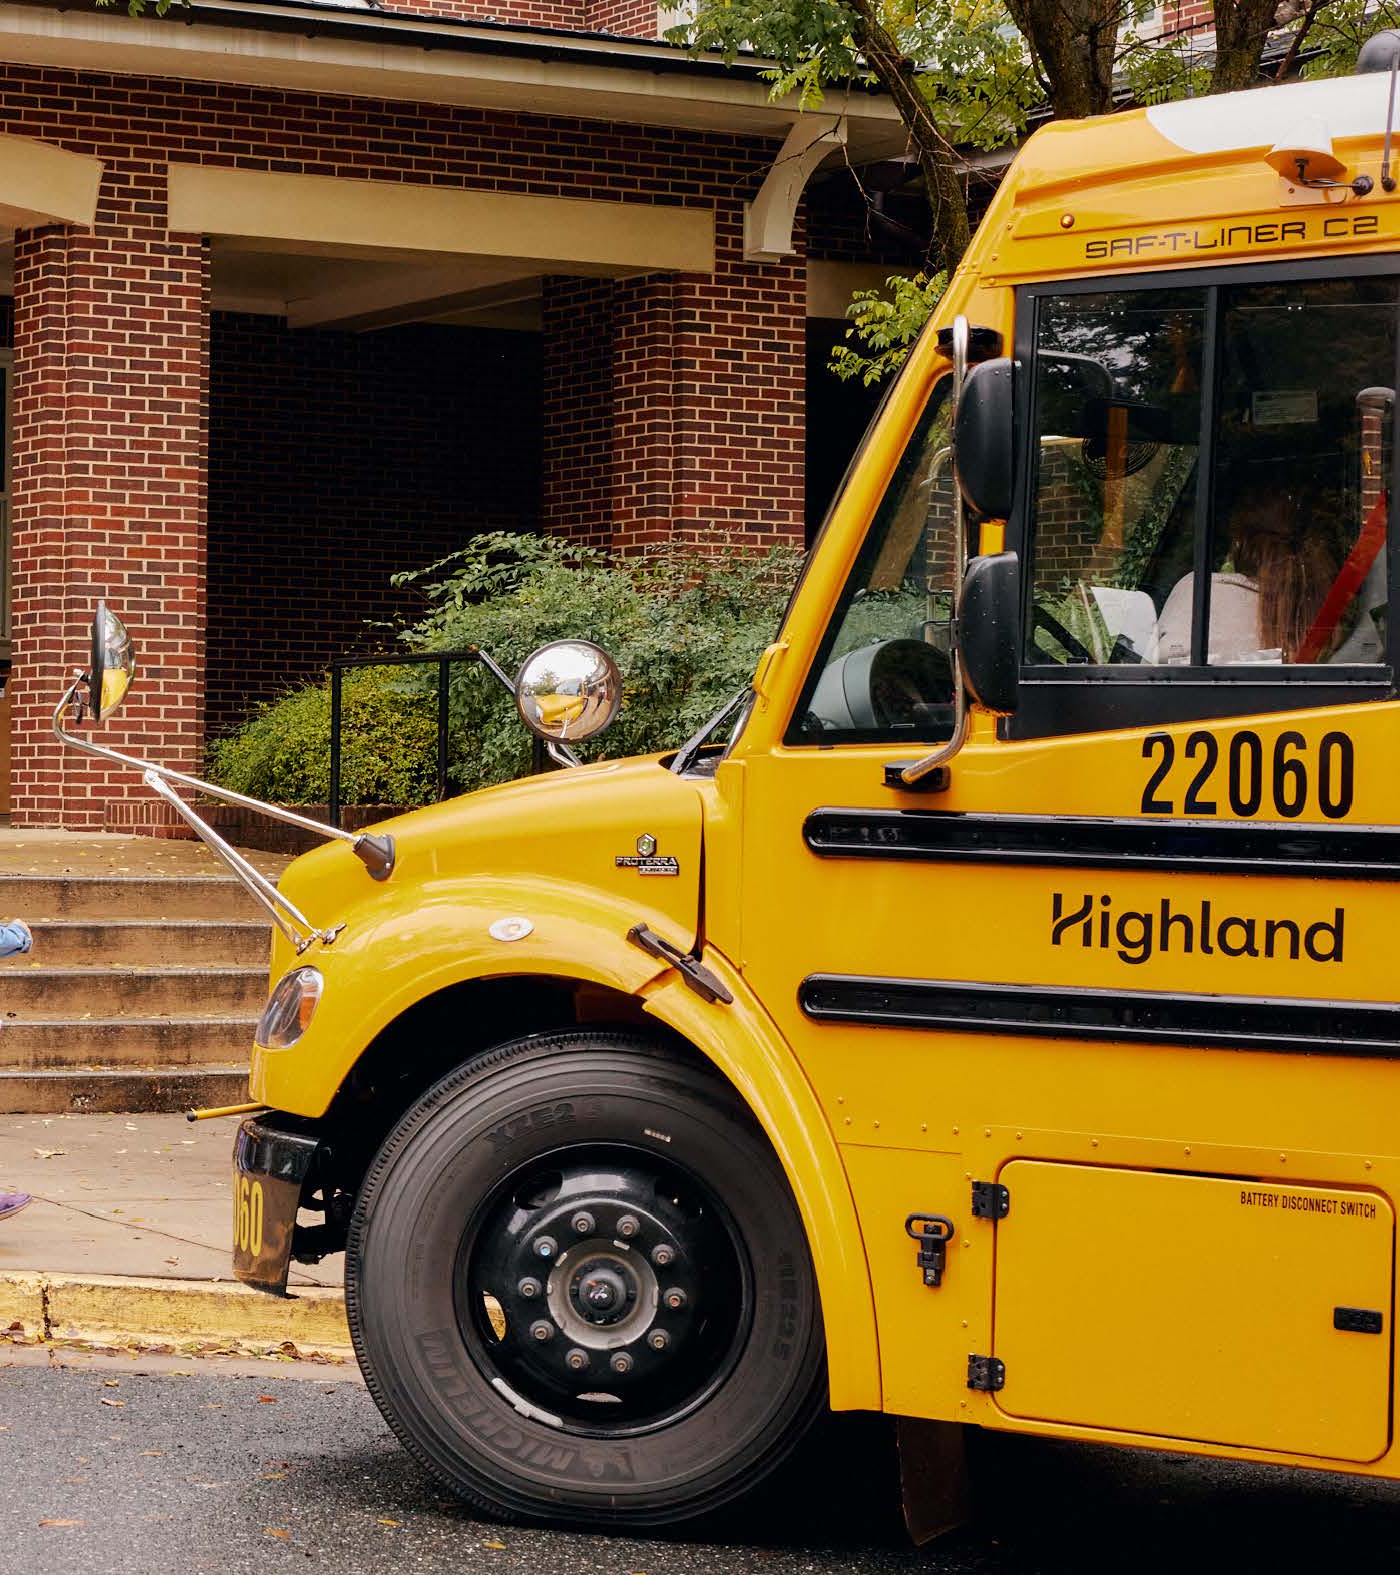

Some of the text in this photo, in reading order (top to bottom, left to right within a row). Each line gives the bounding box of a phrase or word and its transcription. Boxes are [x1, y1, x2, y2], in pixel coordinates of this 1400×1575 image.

[1085, 215, 1379, 259] SAF-T-LINER C2
[1140, 730, 1354, 819] 22060
[616, 857, 677, 866] PROTERRA
[1051, 892, 1345, 965] Highland
[1240, 1191, 1376, 1219] BATTERY DISCONNECT SWITCH
[421, 1332, 576, 1471] MICHELIN
